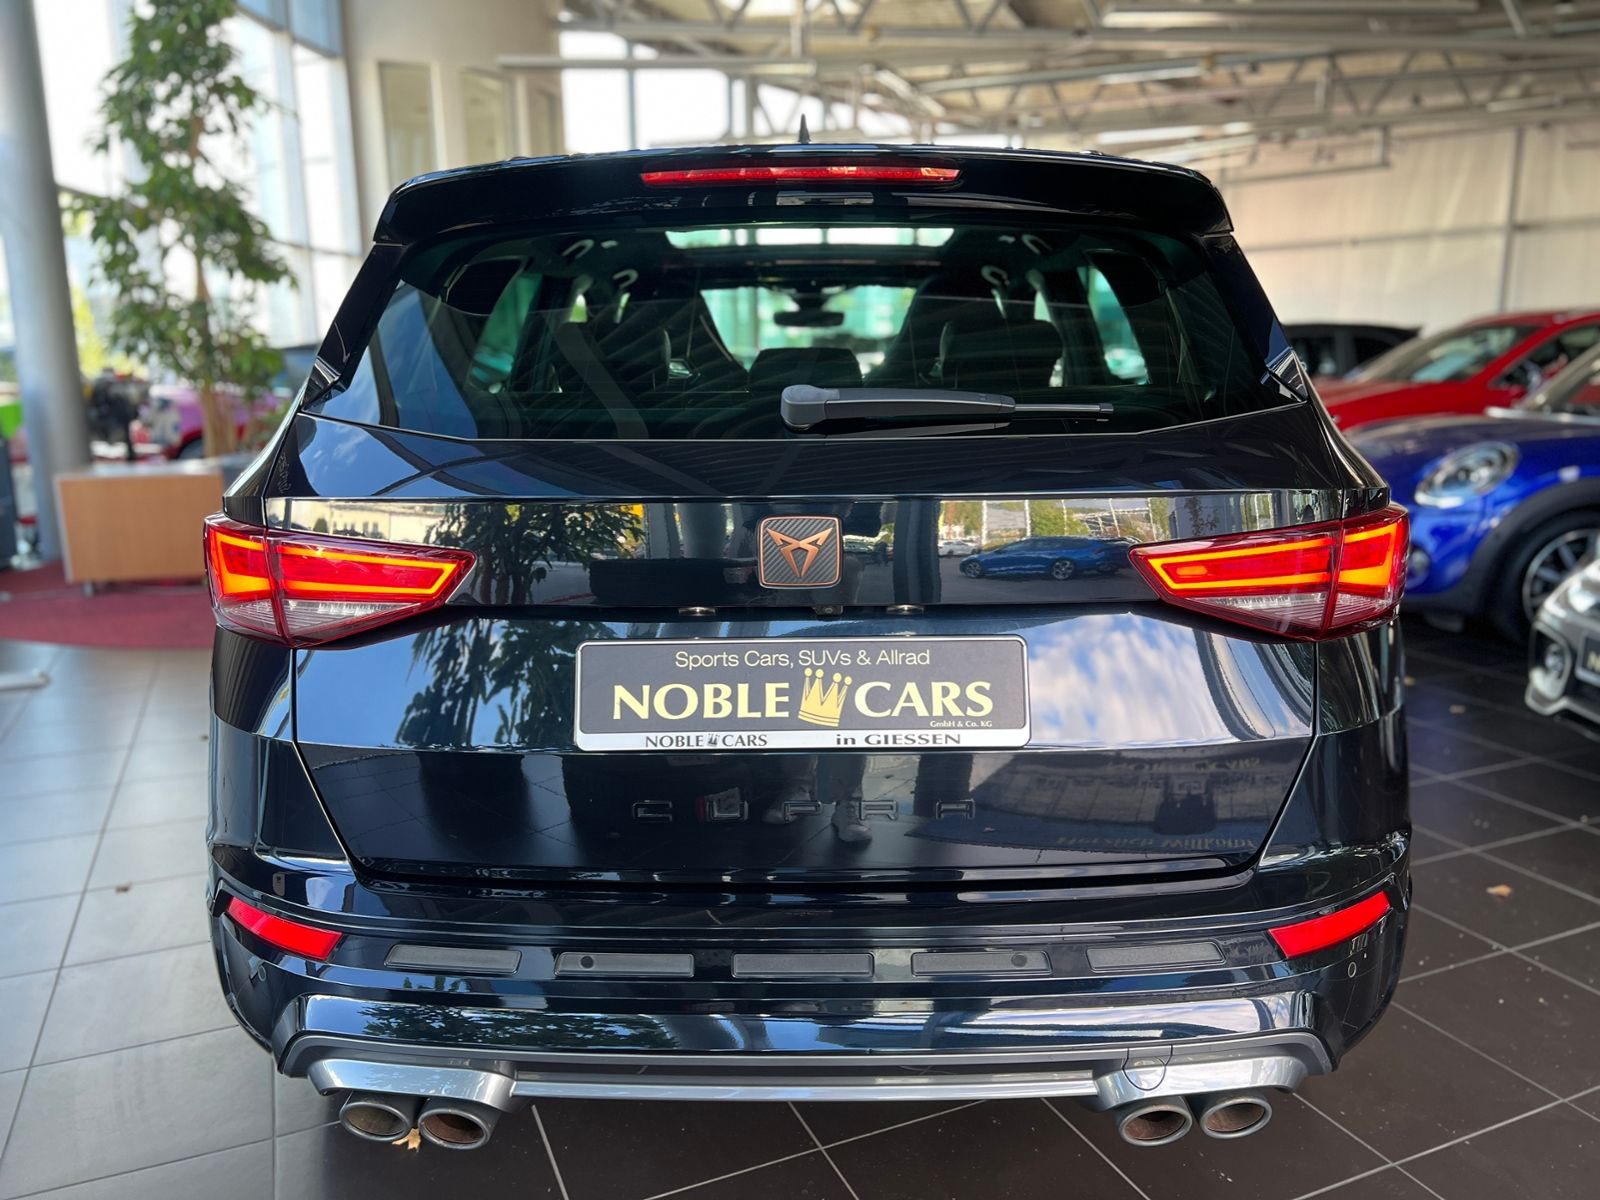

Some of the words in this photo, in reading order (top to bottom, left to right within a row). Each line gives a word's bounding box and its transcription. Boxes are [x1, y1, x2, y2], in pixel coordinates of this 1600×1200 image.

[675, 650, 739, 670] Sports
[744, 650, 794, 668] Cars,
[798, 649, 851, 666] SUVs
[856, 650, 871, 665] &
[876, 649, 930, 665] Allrad
[613, 682, 790, 720] NOBLE
[854, 681, 993, 718] CARS
[930, 720, 955, 728] GmbH
[956, 720, 963, 728] &
[965, 720, 979, 728] Co.
[981, 720, 993, 728] KG
[645, 735, 704, 748] NOBLE
[722, 734, 768, 747] CARS
[836, 733, 856, 745] in
[865, 733, 961, 746] GIESSEN
[631, 799, 976, 822] CUPRA
